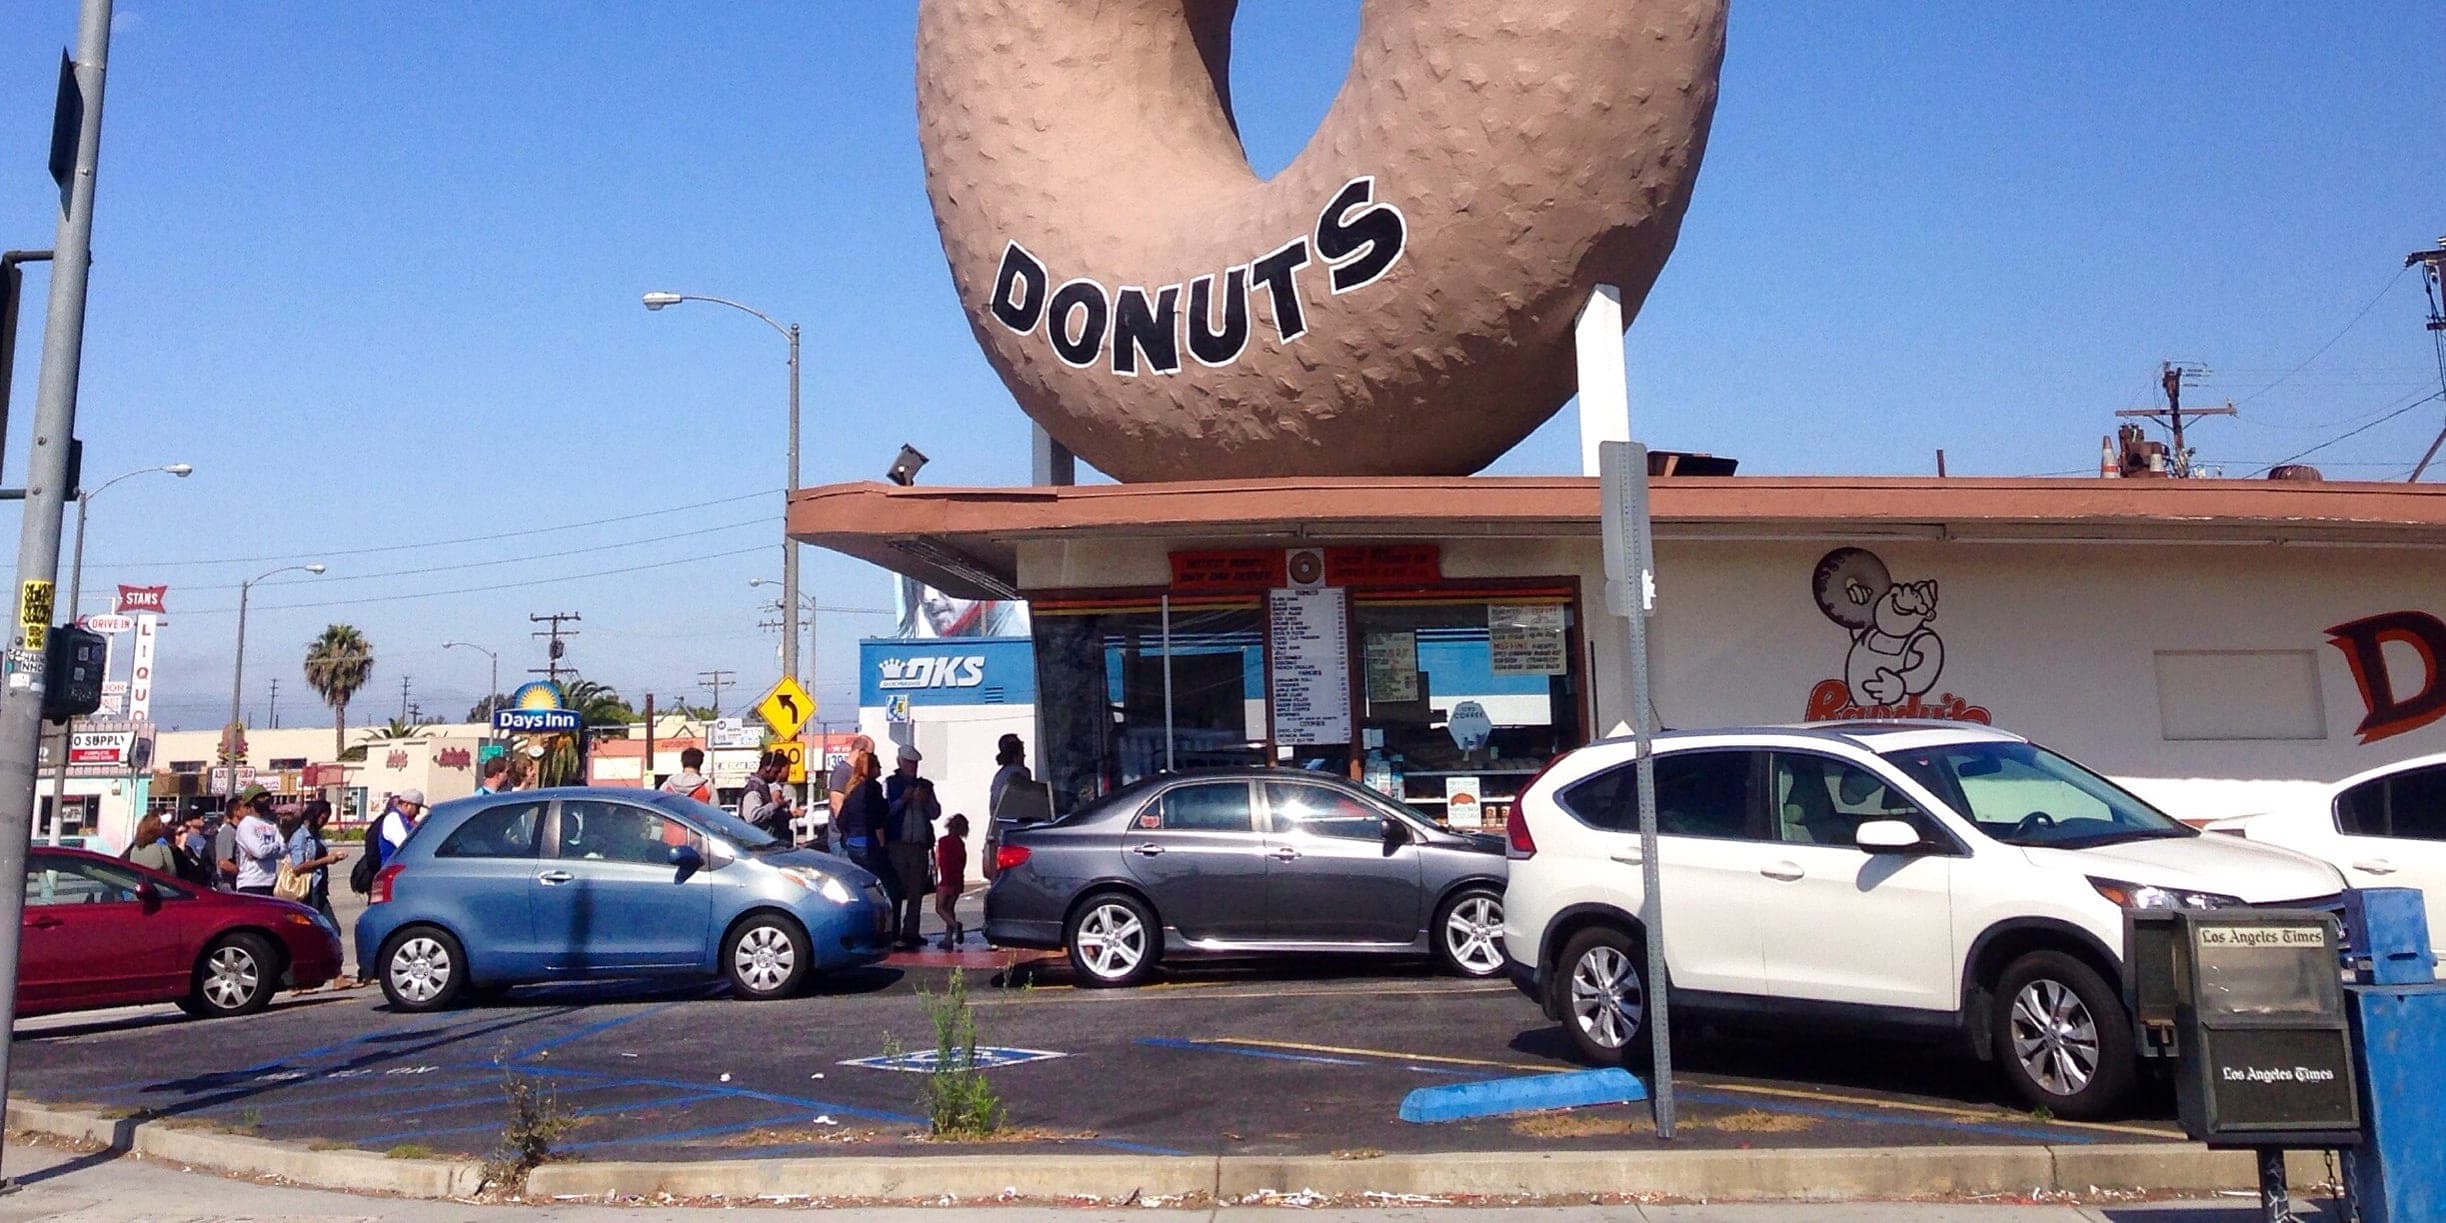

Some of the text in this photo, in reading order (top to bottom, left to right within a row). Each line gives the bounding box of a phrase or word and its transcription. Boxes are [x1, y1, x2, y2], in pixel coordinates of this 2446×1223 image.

[991, 175, 1408, 377] DONUTS
[126, 592, 159, 605] STANS
[92, 618, 119, 629] DRIVE
[500, 711, 575, 729] Days Inn
[1455, 711, 1484, 720] COFFEE
[85, 735, 126, 747] SUPPLY
[2202, 928, 2323, 946] Los Angeles Times
[2223, 1066, 2334, 1083] Los Angeles Times
